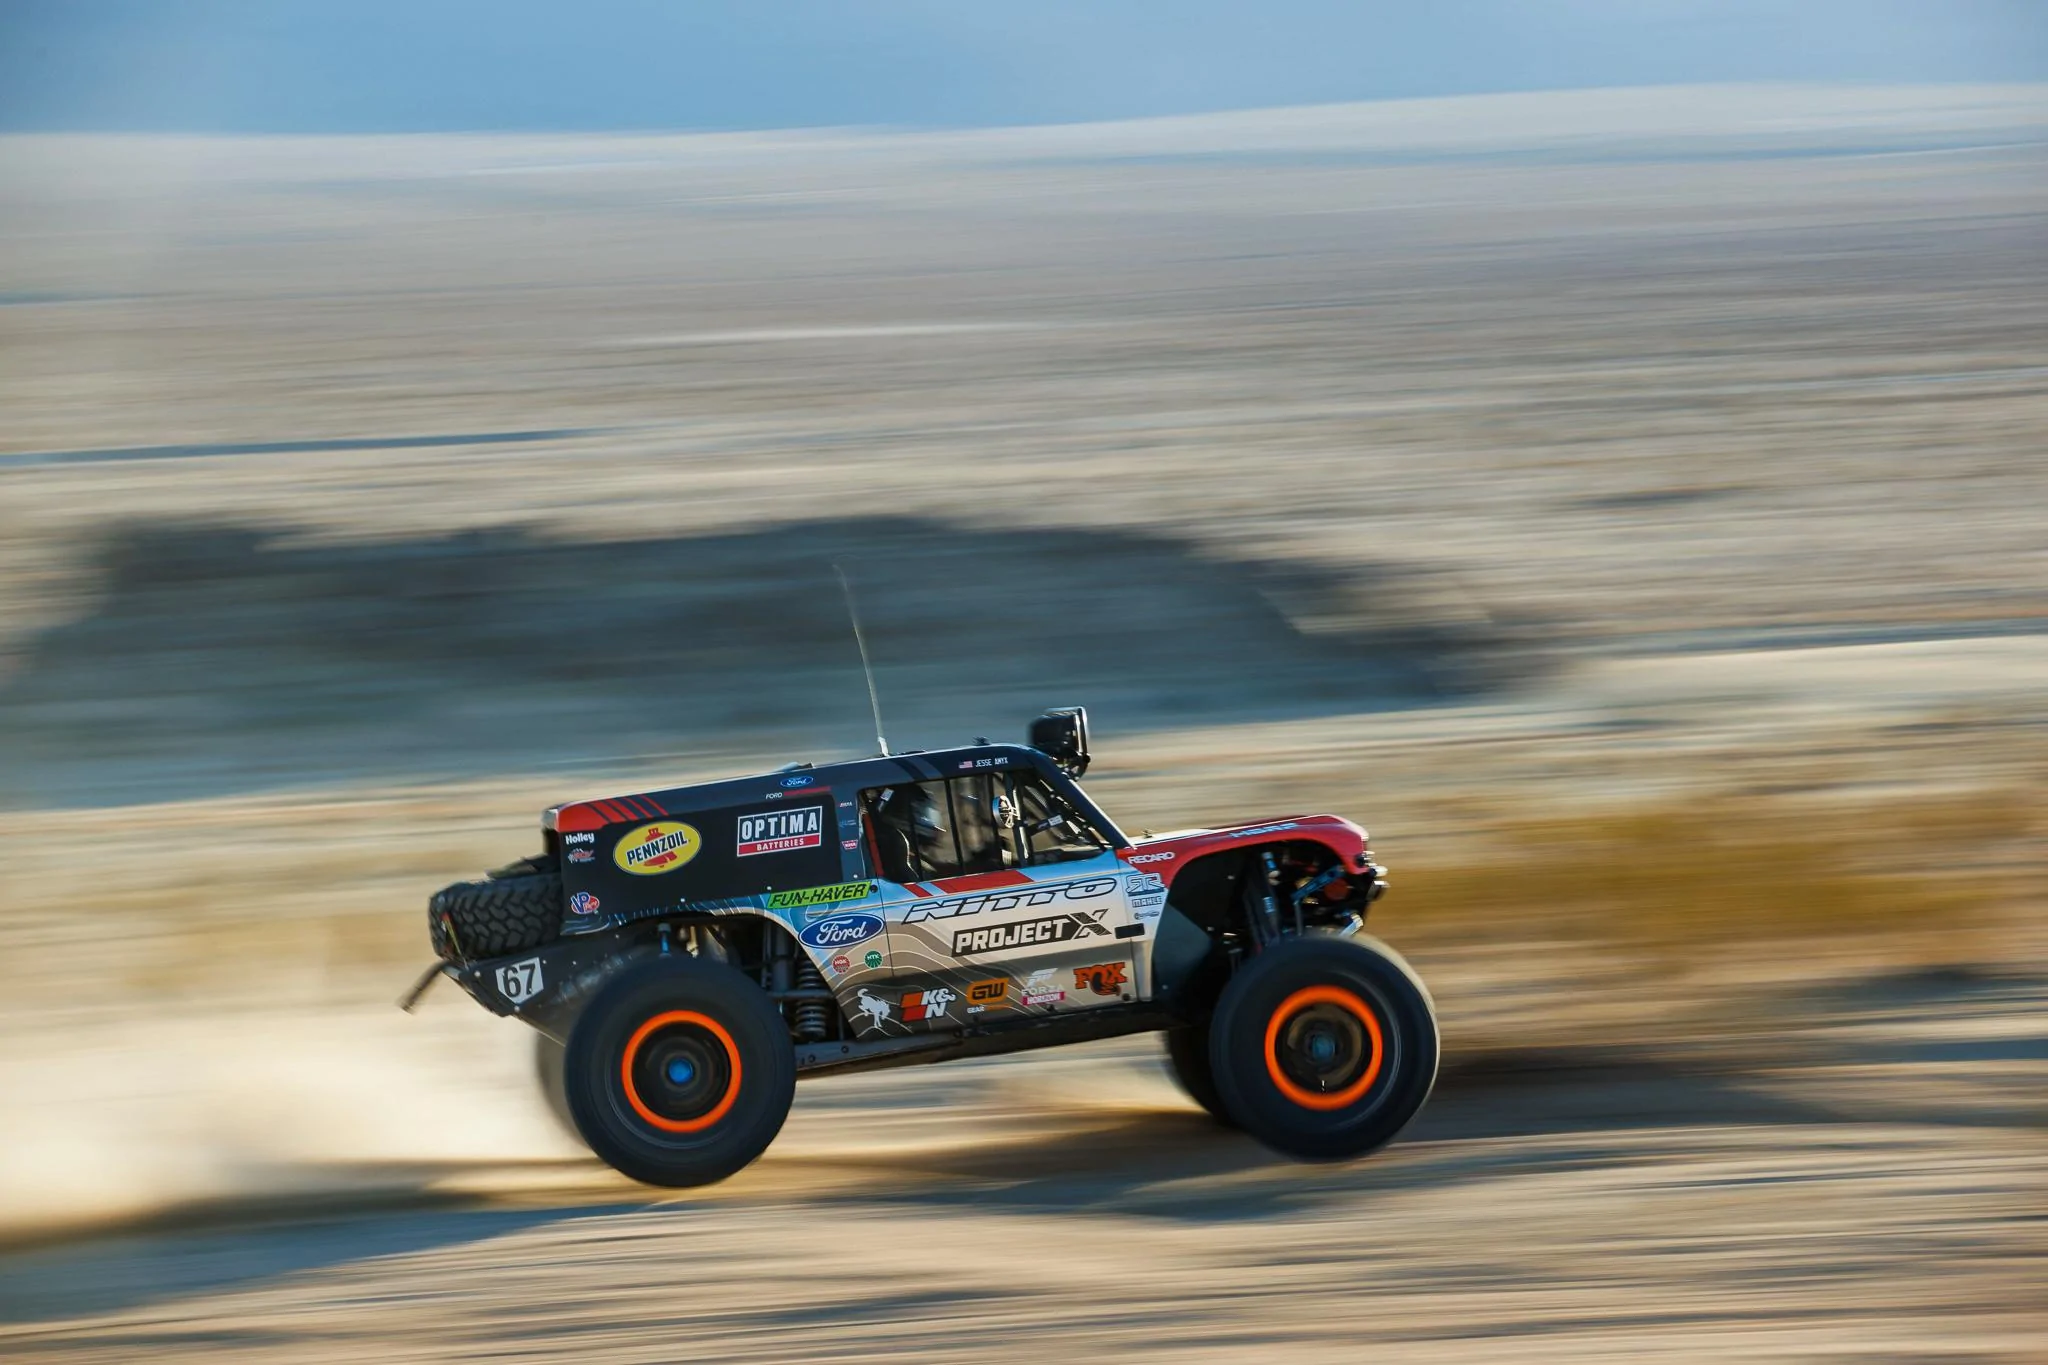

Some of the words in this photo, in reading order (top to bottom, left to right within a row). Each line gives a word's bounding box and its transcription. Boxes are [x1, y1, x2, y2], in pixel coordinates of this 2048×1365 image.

[976, 758, 993, 767] JESSE
[741, 812, 818, 840] OPTIMA
[565, 832, 594, 844] Holley
[626, 831, 688, 865] PENNZOIL
[756, 838, 804, 851] BATTERIES
[1127, 852, 1175, 864] RECARO
[570, 892, 590, 913] VP
[770, 883, 867, 906] FUN-HAVER
[901, 878, 1117, 924] NITTO
[816, 919, 867, 944] Ford
[955, 918, 1071, 953] PROJECT
[502, 963, 535, 997] 67
[1022, 984, 1064, 996] FORZA
[1073, 962, 1128, 996] FOX
[972, 983, 1005, 1001] GW
